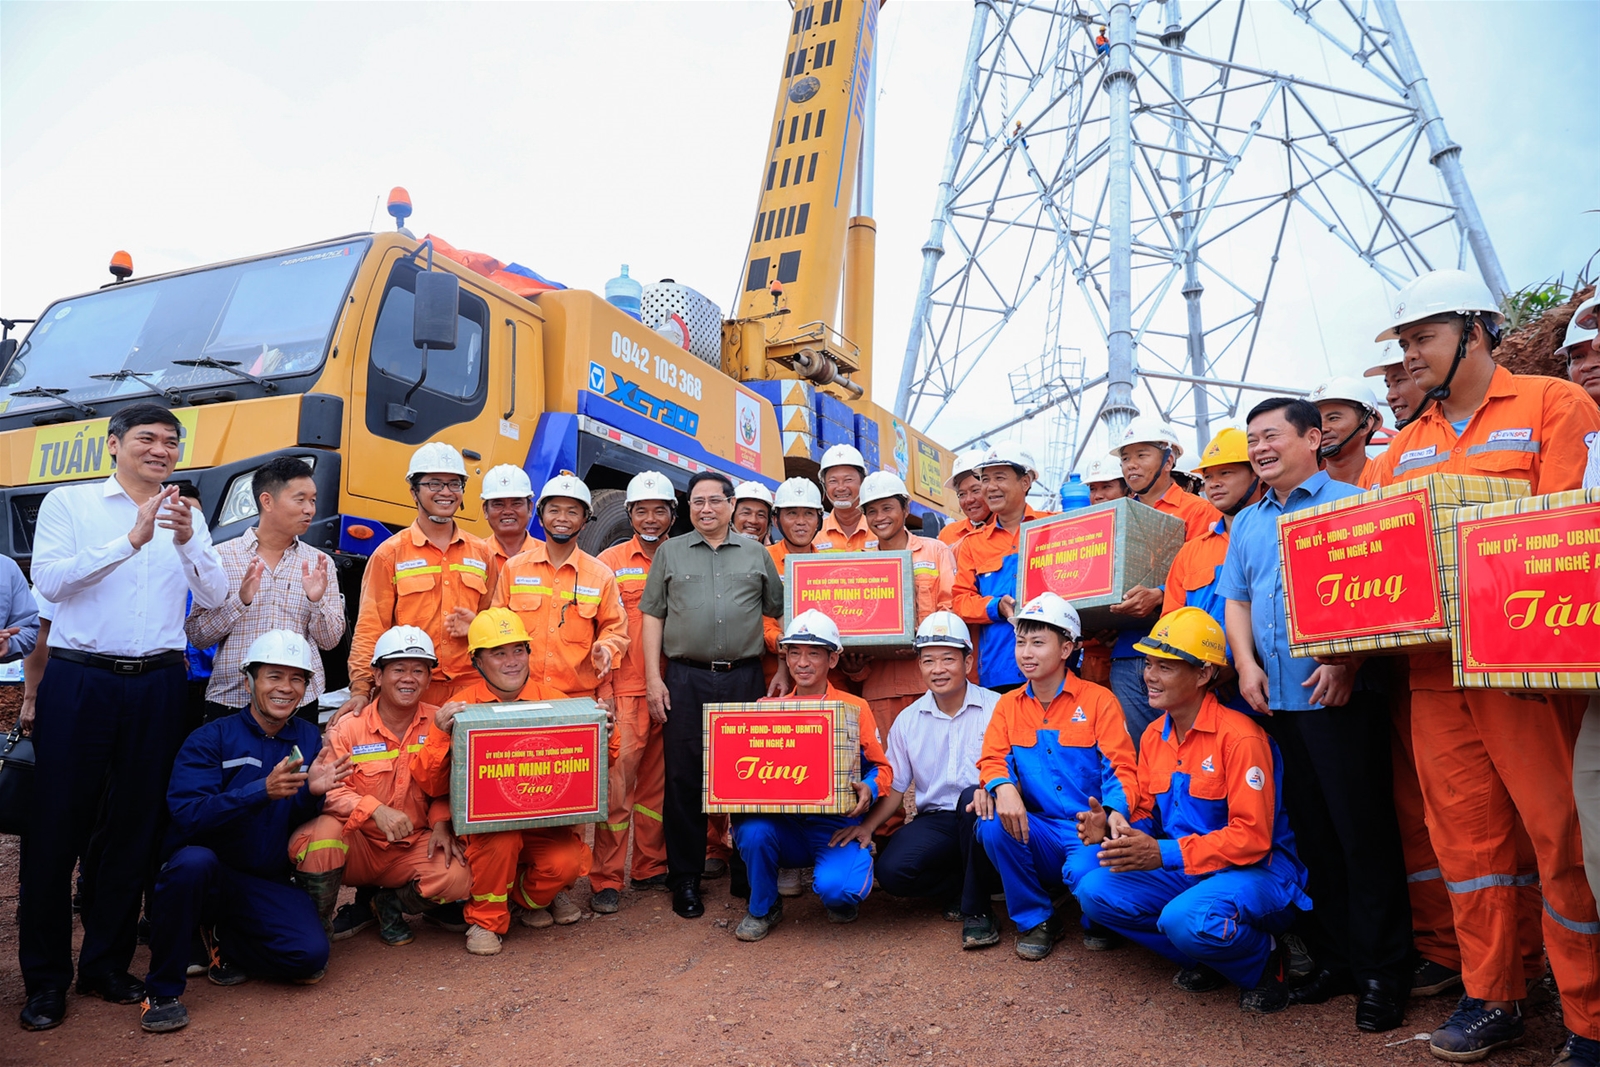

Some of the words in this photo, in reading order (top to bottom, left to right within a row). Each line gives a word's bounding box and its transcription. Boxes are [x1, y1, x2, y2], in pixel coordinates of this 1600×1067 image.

[611, 331, 650, 374] 0942
[654, 355, 677, 388] 103
[678, 369, 702, 401] 368
[604, 371, 699, 437] XCT300
[38, 426, 105, 478] TUẤN
[1085, 533, 1095, 541] CHÍNH
[1295, 535, 1312, 550] TỈNH
[1327, 528, 1351, 543] HĐND-
[1352, 521, 1378, 538] UBND-
[1379, 512, 1416, 531] UBMTTQ
[1328, 546, 1346, 562] TỈNH
[1346, 540, 1368, 558] NGHỆ
[1370, 540, 1383, 554] AN
[1477, 537, 1501, 556] TỈNH
[1525, 533, 1564, 551] HĐND-
[1030, 553, 1053, 570] PHẠM
[1055, 548, 1078, 565] MINH
[1080, 542, 1107, 559] CHÍNH
[1524, 555, 1552, 575] TỈNH
[1555, 551, 1590, 573] NGHỆ
[828, 577, 839, 585] CHÍNH
[869, 576, 880, 584] CHÍNH
[1053, 569, 1079, 581] Tặng
[802, 589, 831, 604] PHẠM
[833, 588, 860, 601] MINH
[863, 585, 895, 599] CHÍNH
[1316, 573, 1408, 608] Tặng
[832, 605, 864, 617] Tặng
[1201, 638, 1217, 650] SÔNG
[721, 722, 736, 734] TỈNH
[750, 725, 771, 734] HĐND-
[772, 724, 794, 734] UBND-
[795, 724, 823, 735] UBMTTQ
[493, 750, 503, 759] VIÊN
[512, 748, 525, 758] CHÍNH
[560, 746, 574, 755] CHÍNH
[749, 736, 765, 748] TỈNH
[765, 737, 784, 750] NGHỆ
[785, 739, 796, 748] AN
[479, 764, 515, 781] PHẠM
[519, 761, 551, 777] MINH
[554, 756, 590, 774] CHÍNH
[735, 756, 810, 785] Tặng
[516, 782, 553, 796] Tặng
